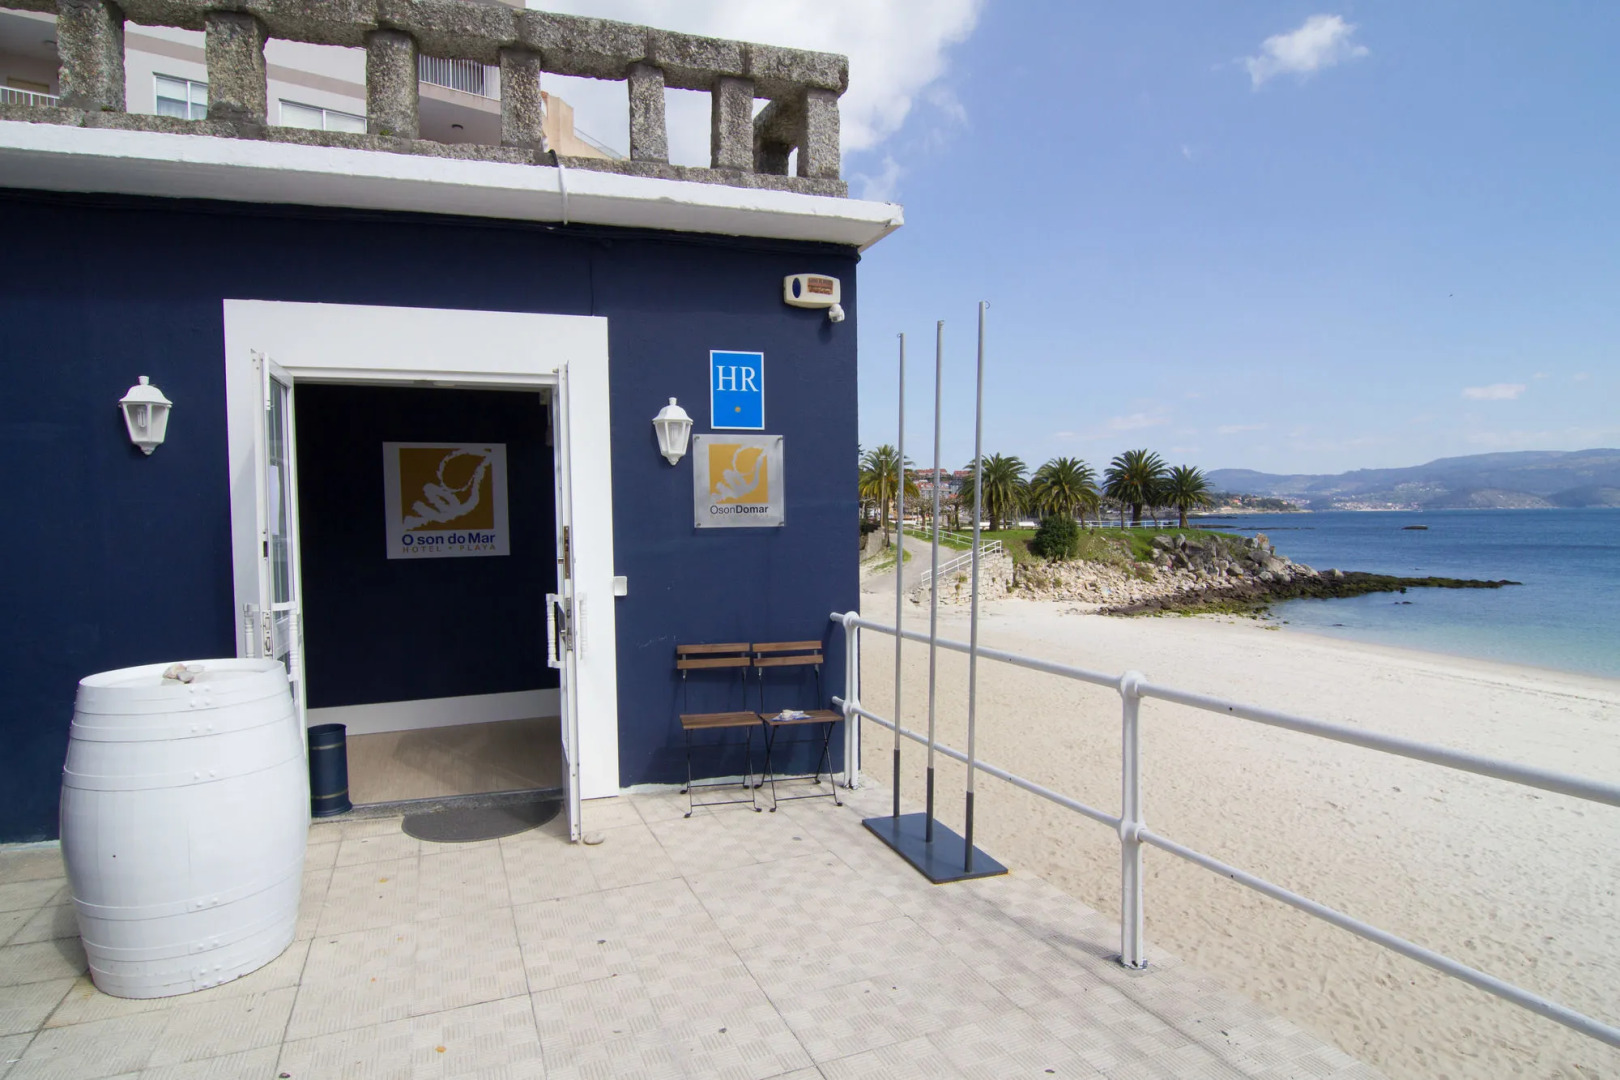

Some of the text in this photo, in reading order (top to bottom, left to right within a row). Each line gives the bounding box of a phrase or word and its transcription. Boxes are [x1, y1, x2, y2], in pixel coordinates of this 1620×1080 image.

[716, 365, 759, 392] HR
[710, 504, 769, 515] OsonDomar
[401, 532, 496, 546] O son do Mar
[402, 545, 441, 553] HOTEL
